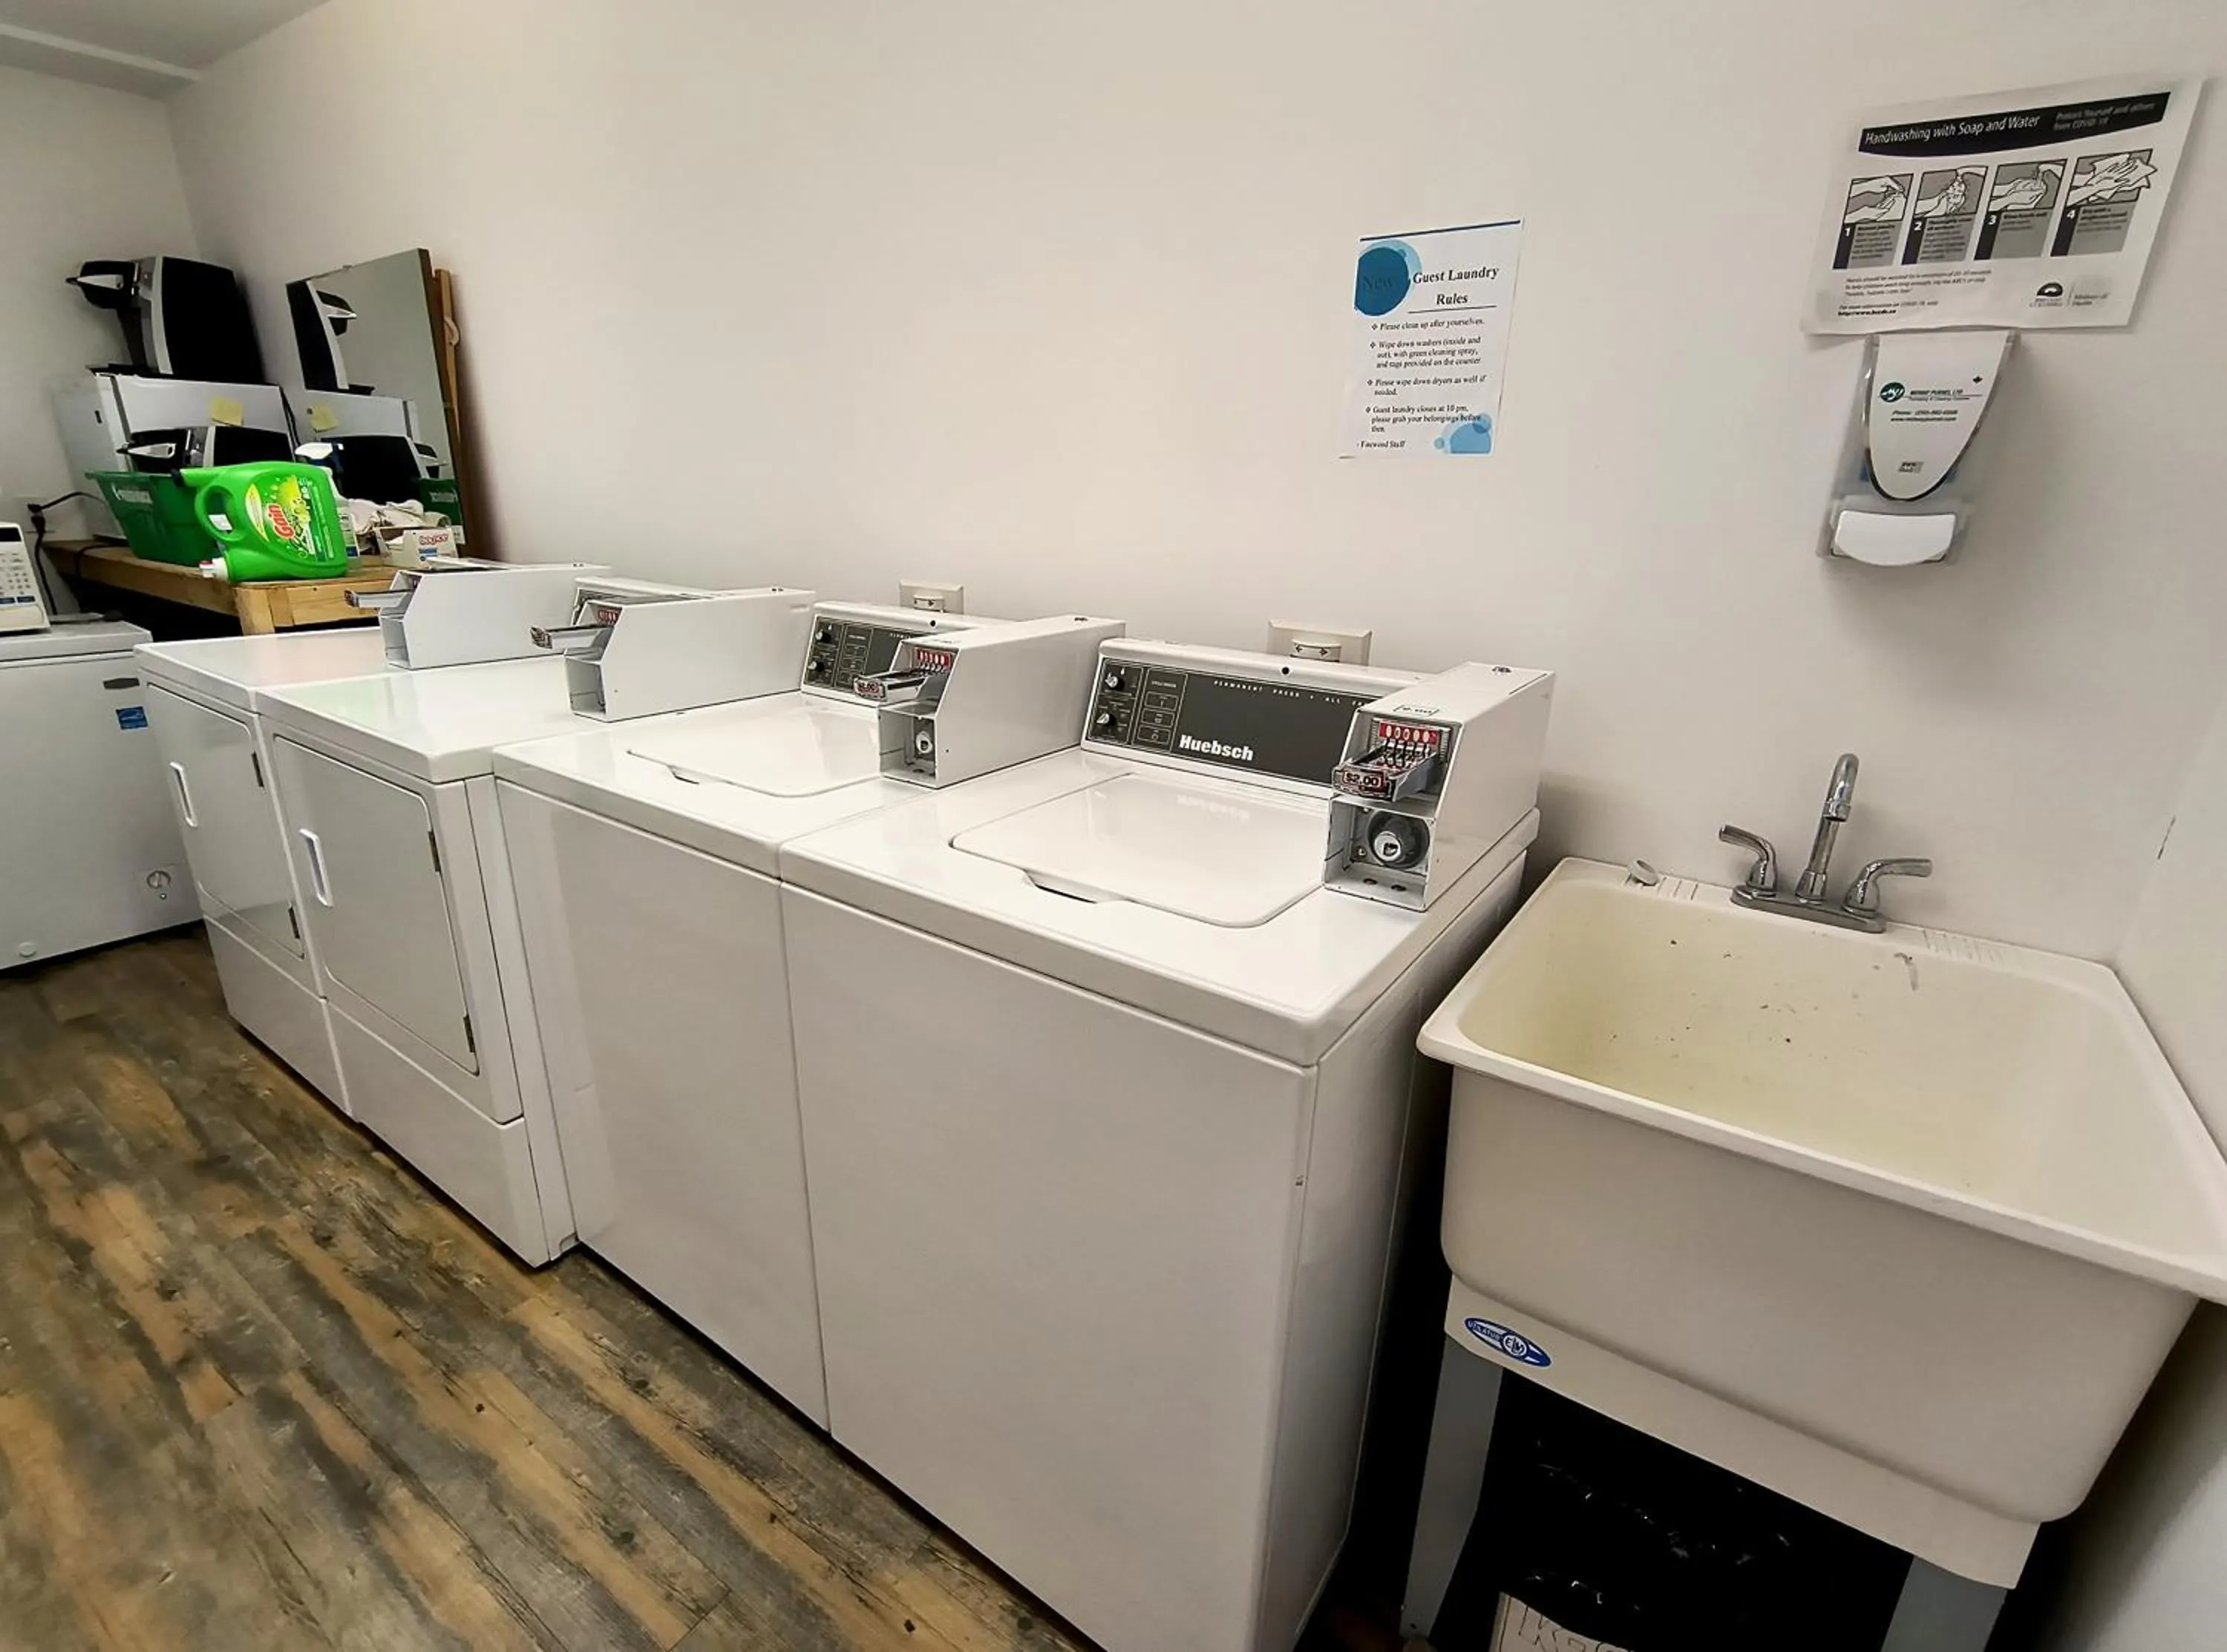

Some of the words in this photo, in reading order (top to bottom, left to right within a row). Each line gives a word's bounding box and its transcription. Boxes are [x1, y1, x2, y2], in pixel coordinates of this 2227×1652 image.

[1865, 128, 1930, 144] Handwashing
[1933, 124, 1955, 138] with
[1958, 122, 1983, 136] Soap
[1985, 117, 2005, 131] and
[2008, 115, 2040, 129] Water
[1989, 214, 1997, 225] 3
[2066, 209, 2076, 220] 4
[1844, 228, 1851, 237] 1
[1914, 222, 1922, 232] 2
[1413, 271, 1445, 284] Guest
[1448, 266, 1500, 281] Laundry
[1436, 292, 1468, 306] Rules
[1379, 322, 1400, 331] Please
[1430, 319, 1445, 328] after
[1397, 340, 1414, 348] down
[1468, 335, 1481, 344] and
[1428, 348, 1456, 357] cleaning
[1404, 358, 1432, 368] provided
[1392, 405, 1415, 415] laundry
[1371, 415, 1390, 425] please
[1407, 416, 1422, 425] your
[266, 503, 295, 540] Gain
[1179, 734, 1254, 761] Huebsch
